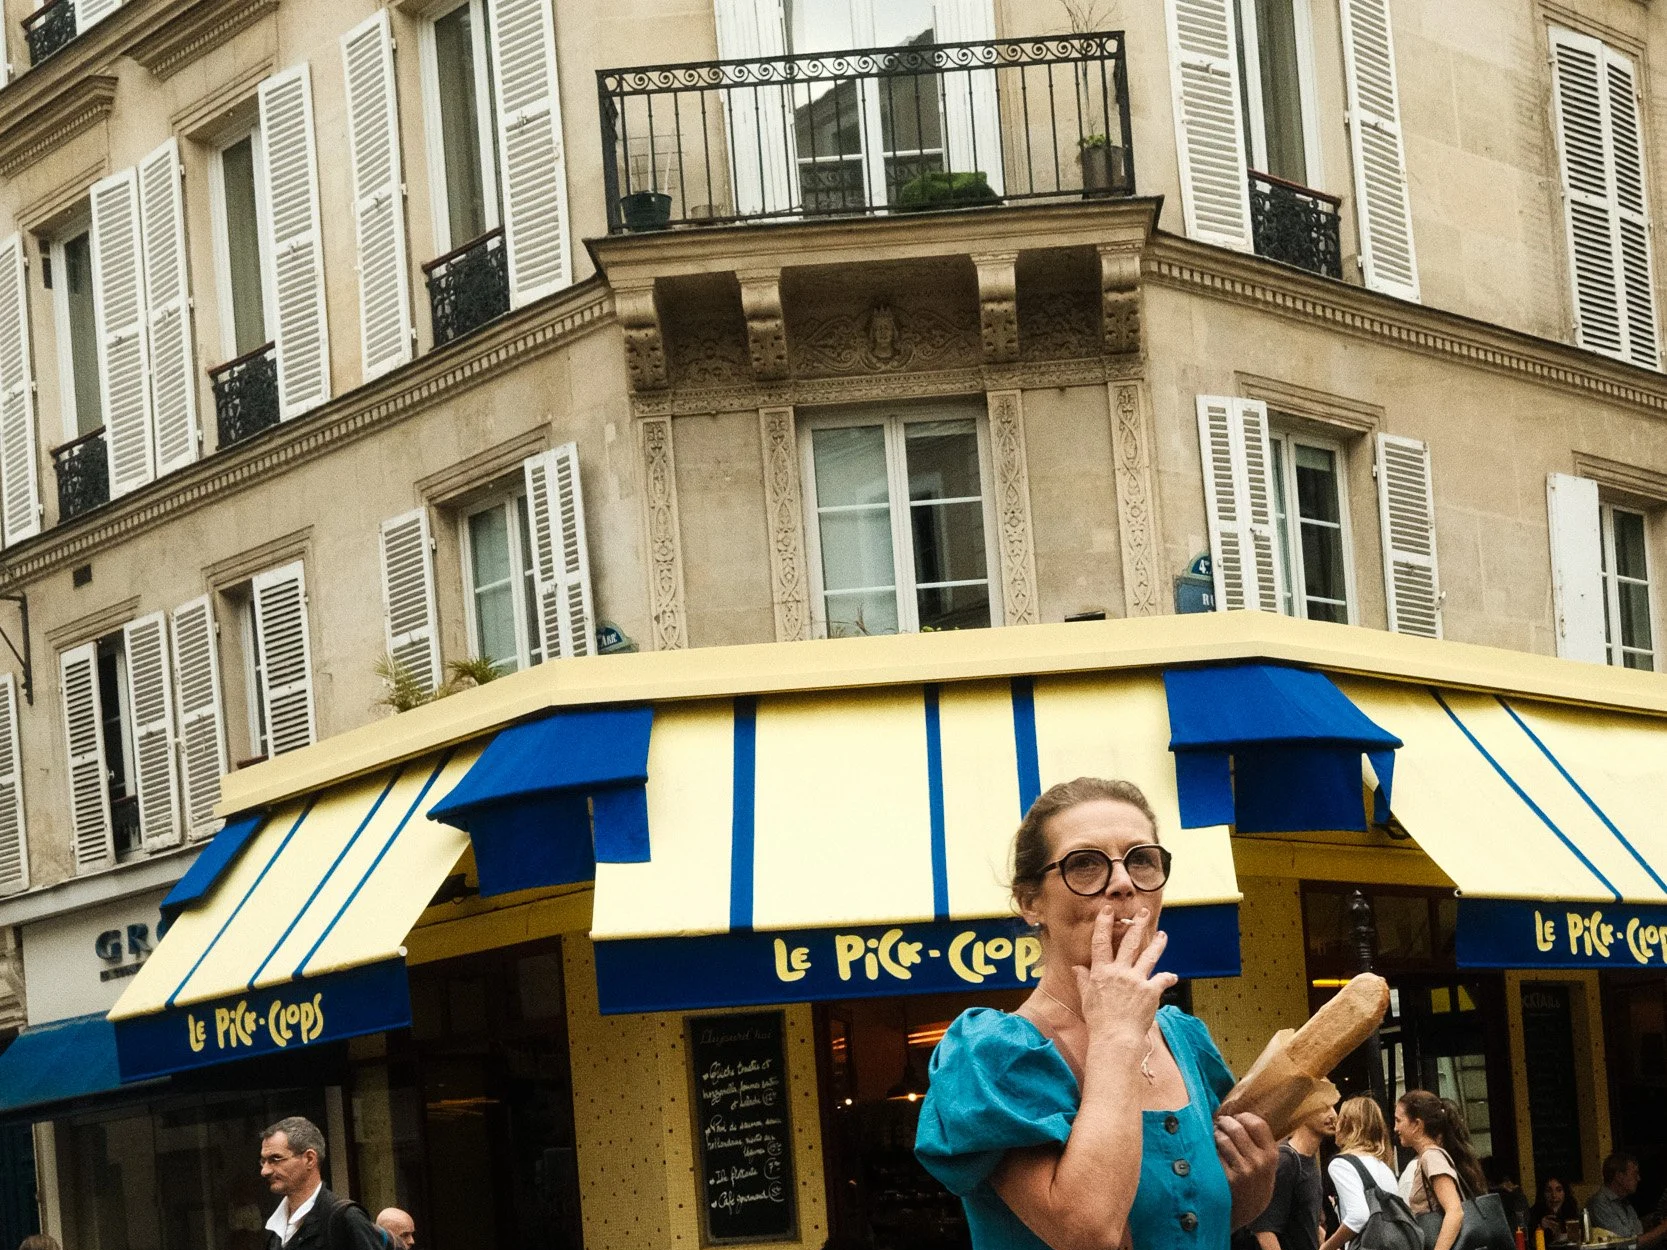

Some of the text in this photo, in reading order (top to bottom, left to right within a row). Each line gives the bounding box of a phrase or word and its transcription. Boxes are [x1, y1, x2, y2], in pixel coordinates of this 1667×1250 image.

[1535, 910, 1556, 952] LE
[774, 928, 1045, 984] LE PiCK-CLOP
[188, 1013, 206, 1052] LE
